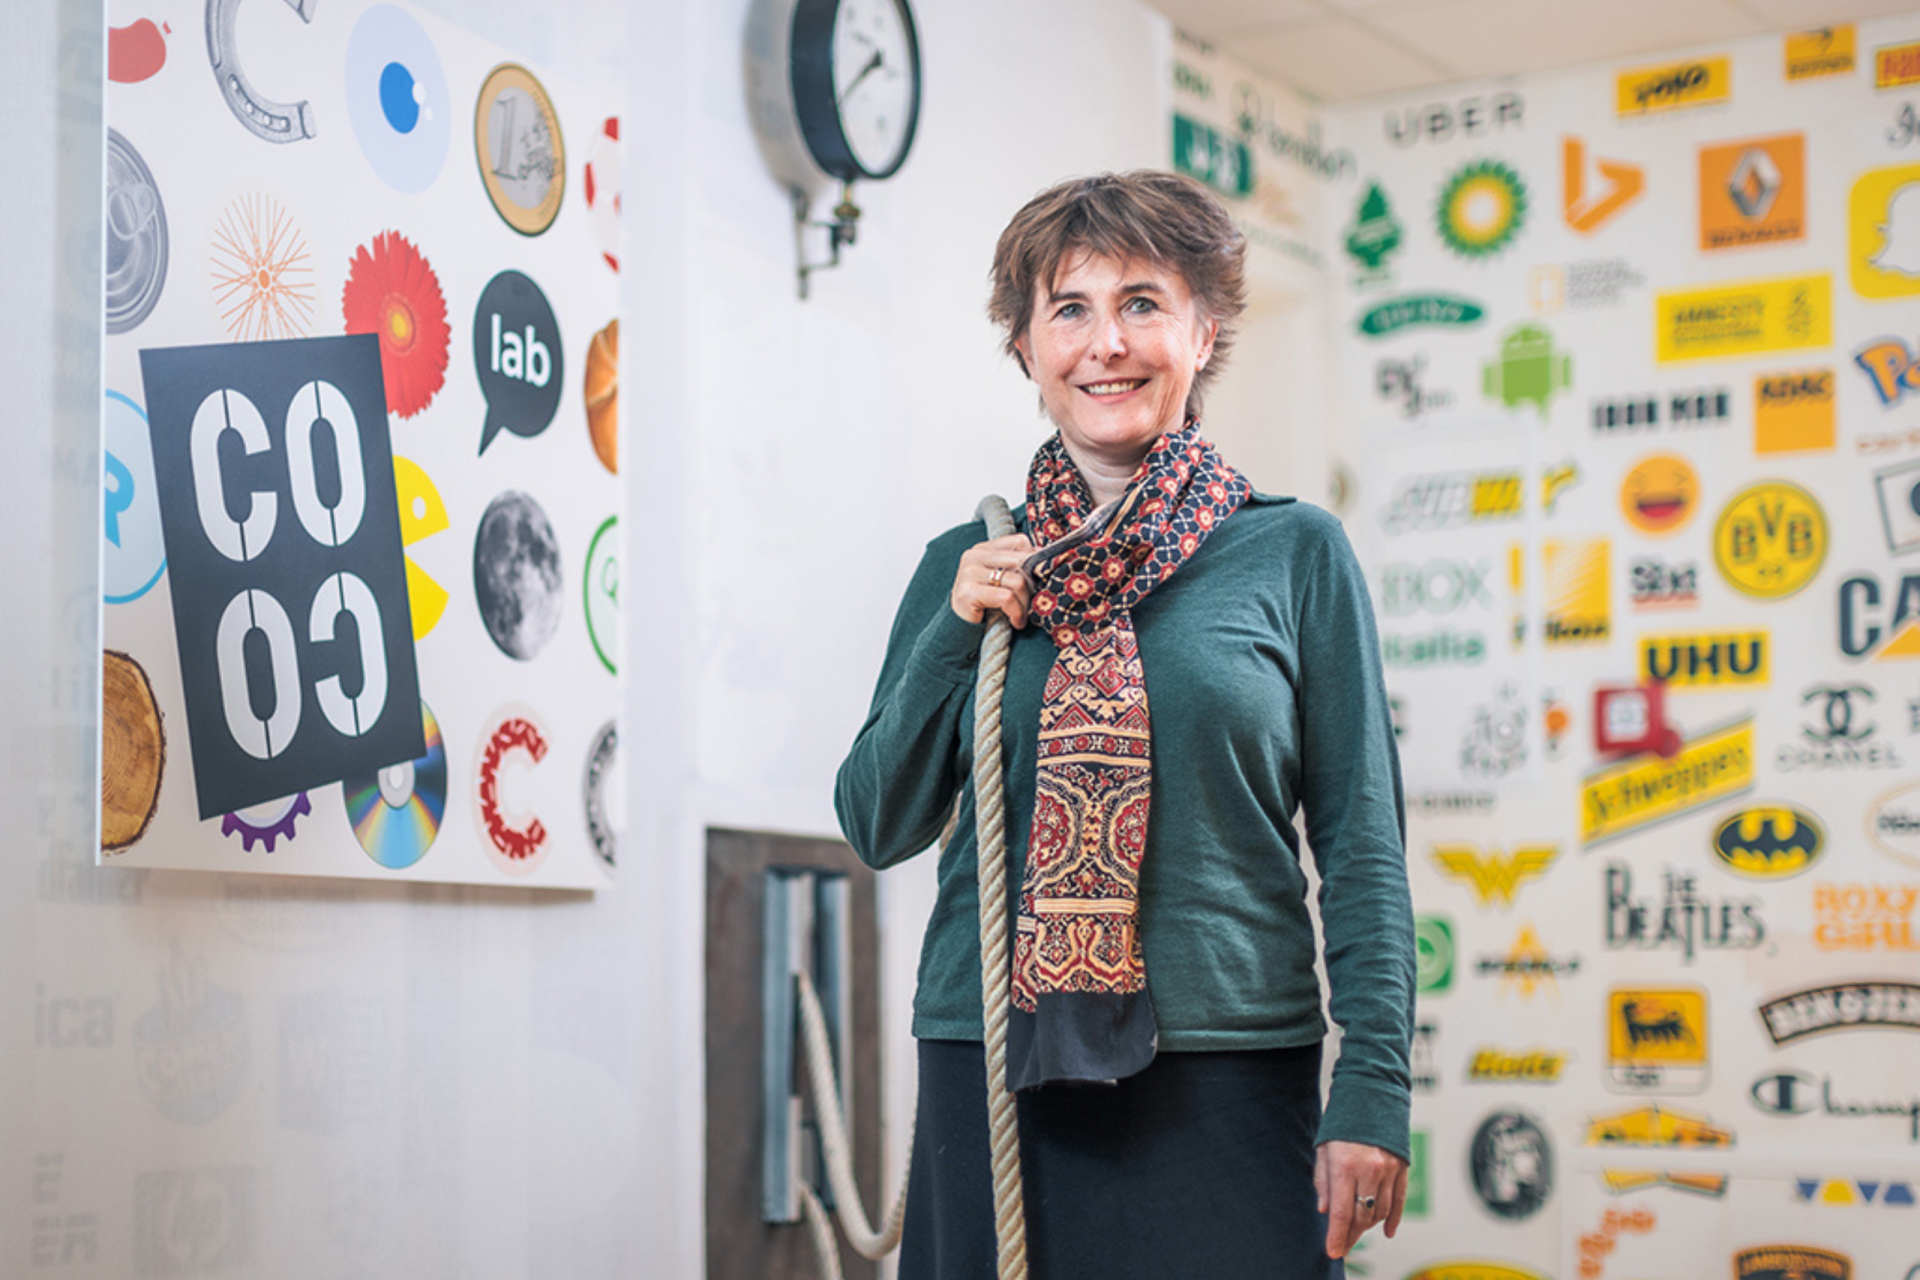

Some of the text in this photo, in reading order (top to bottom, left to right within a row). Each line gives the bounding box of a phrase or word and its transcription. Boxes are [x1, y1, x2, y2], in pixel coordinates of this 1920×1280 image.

[1384, 93, 1526, 148] UBER
[490, 314, 552, 388] lab
[1647, 640, 1762, 682] UHU
[1777, 740, 1899, 772] CHANEL
[1605, 864, 1765, 963] BEATLES
